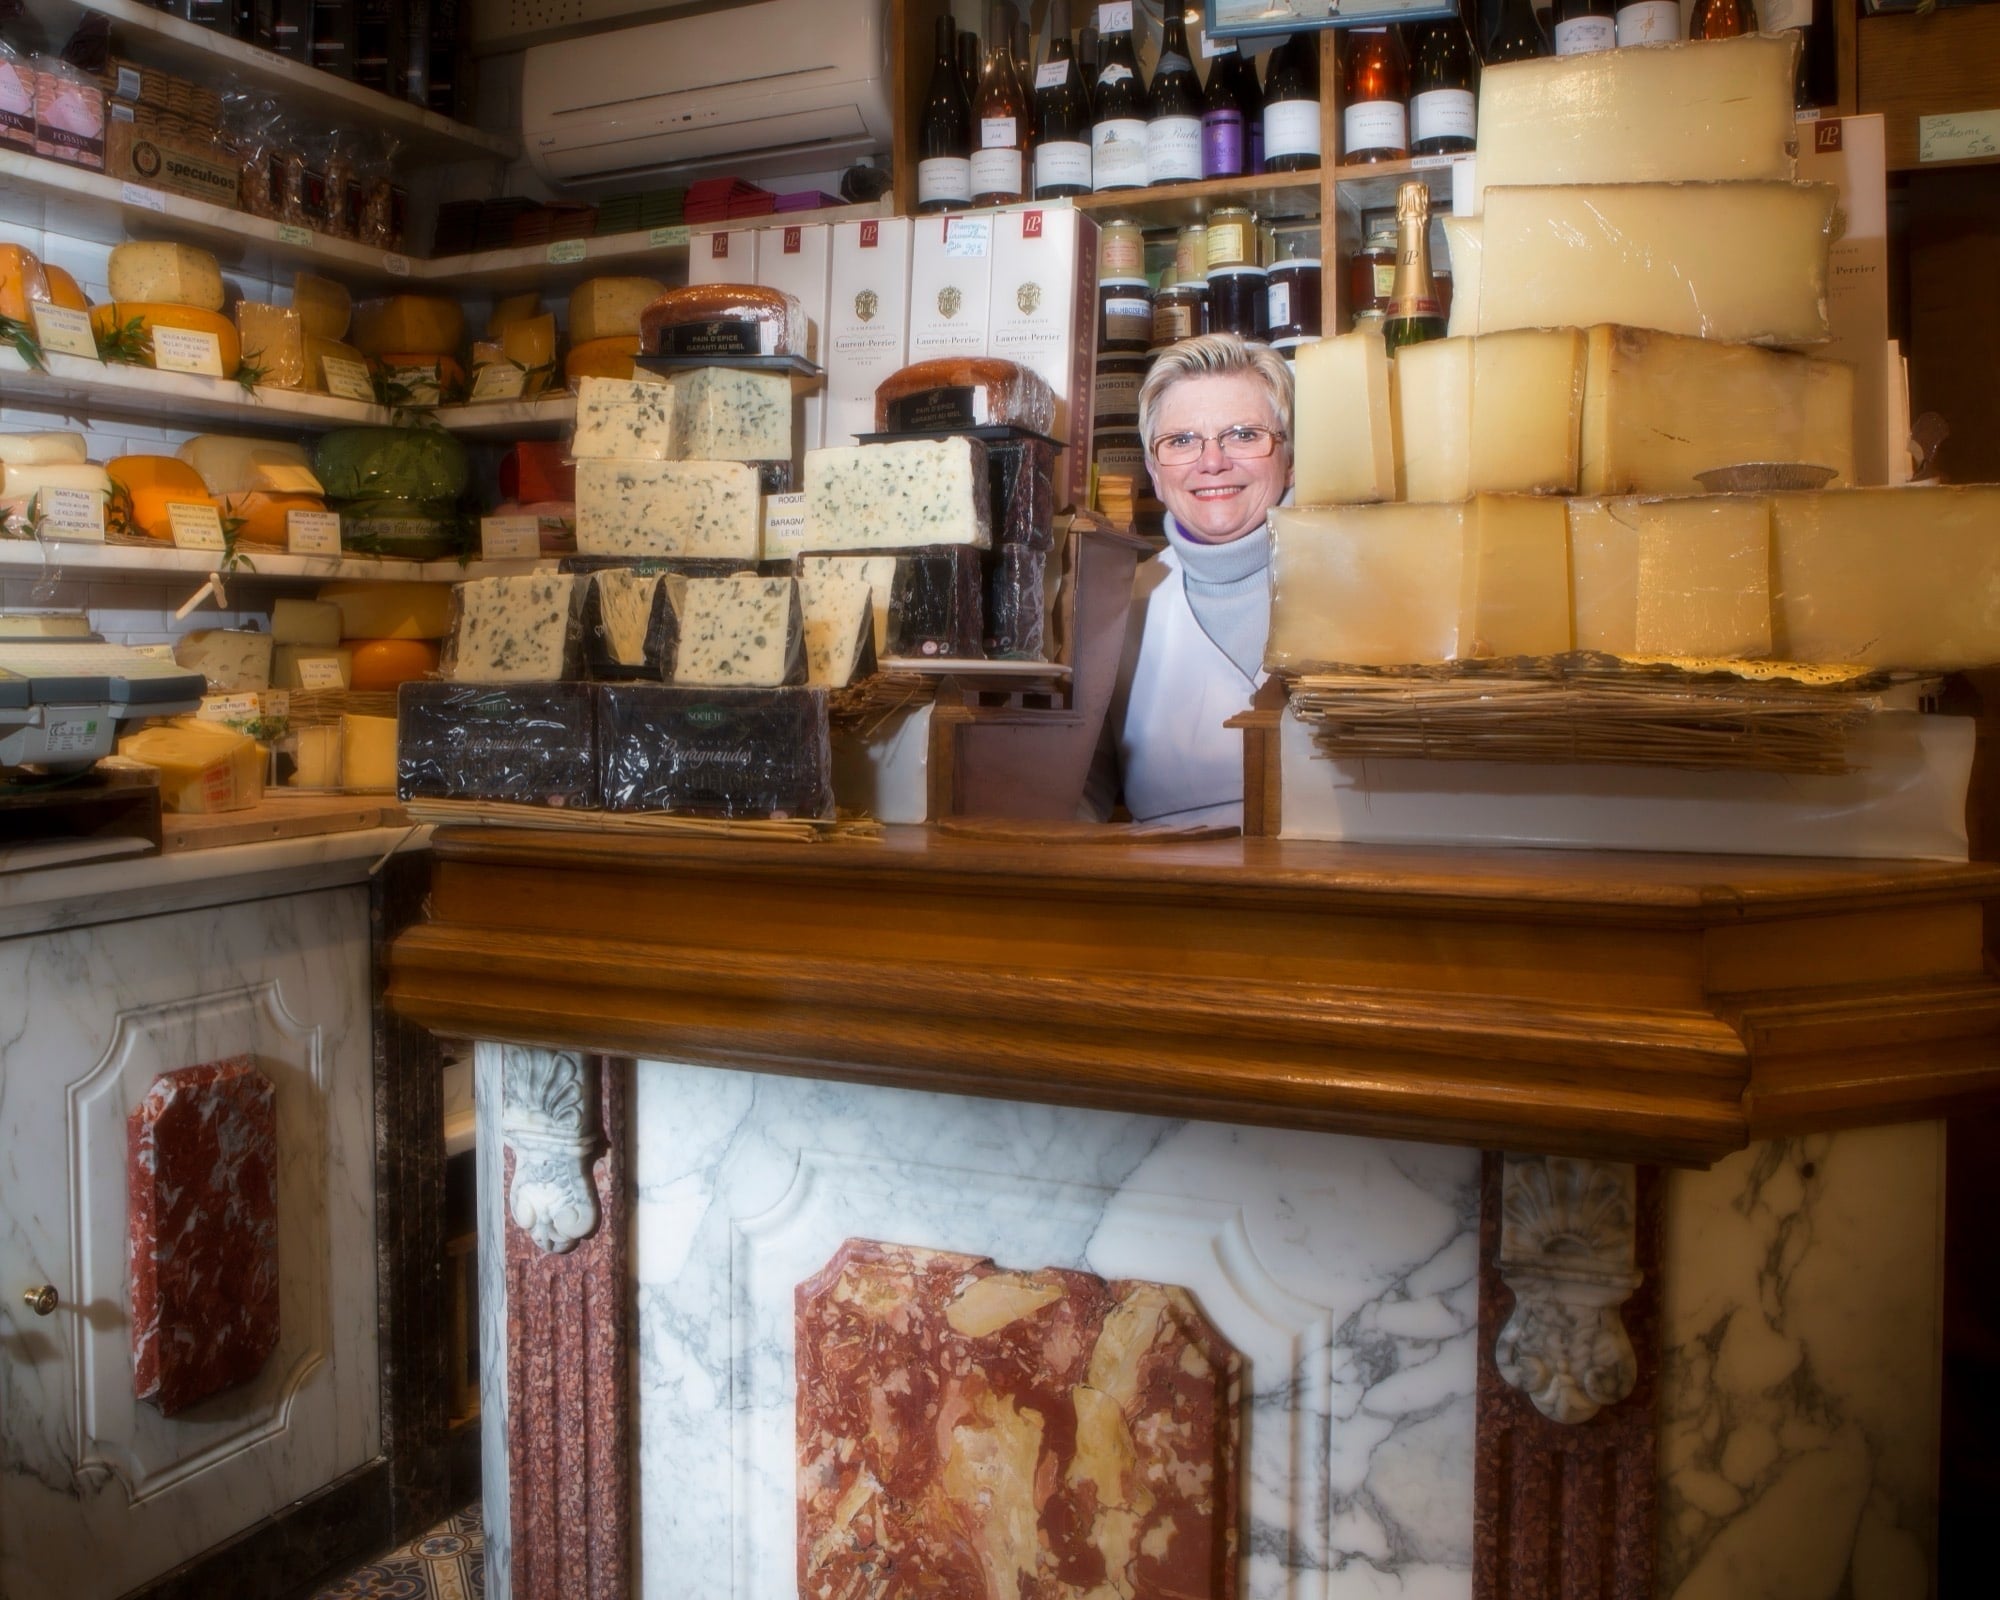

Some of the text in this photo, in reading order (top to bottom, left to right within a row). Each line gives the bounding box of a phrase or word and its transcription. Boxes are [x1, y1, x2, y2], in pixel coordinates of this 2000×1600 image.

[166, 160, 235, 190] speculoos
[916, 336, 980, 345] Laurent-Perrier
[995, 333, 1061, 343] Laurent-Perrier
[836, 339, 896, 349] Laurent-Perrier
[660, 738, 752, 769] Baragnaudes
